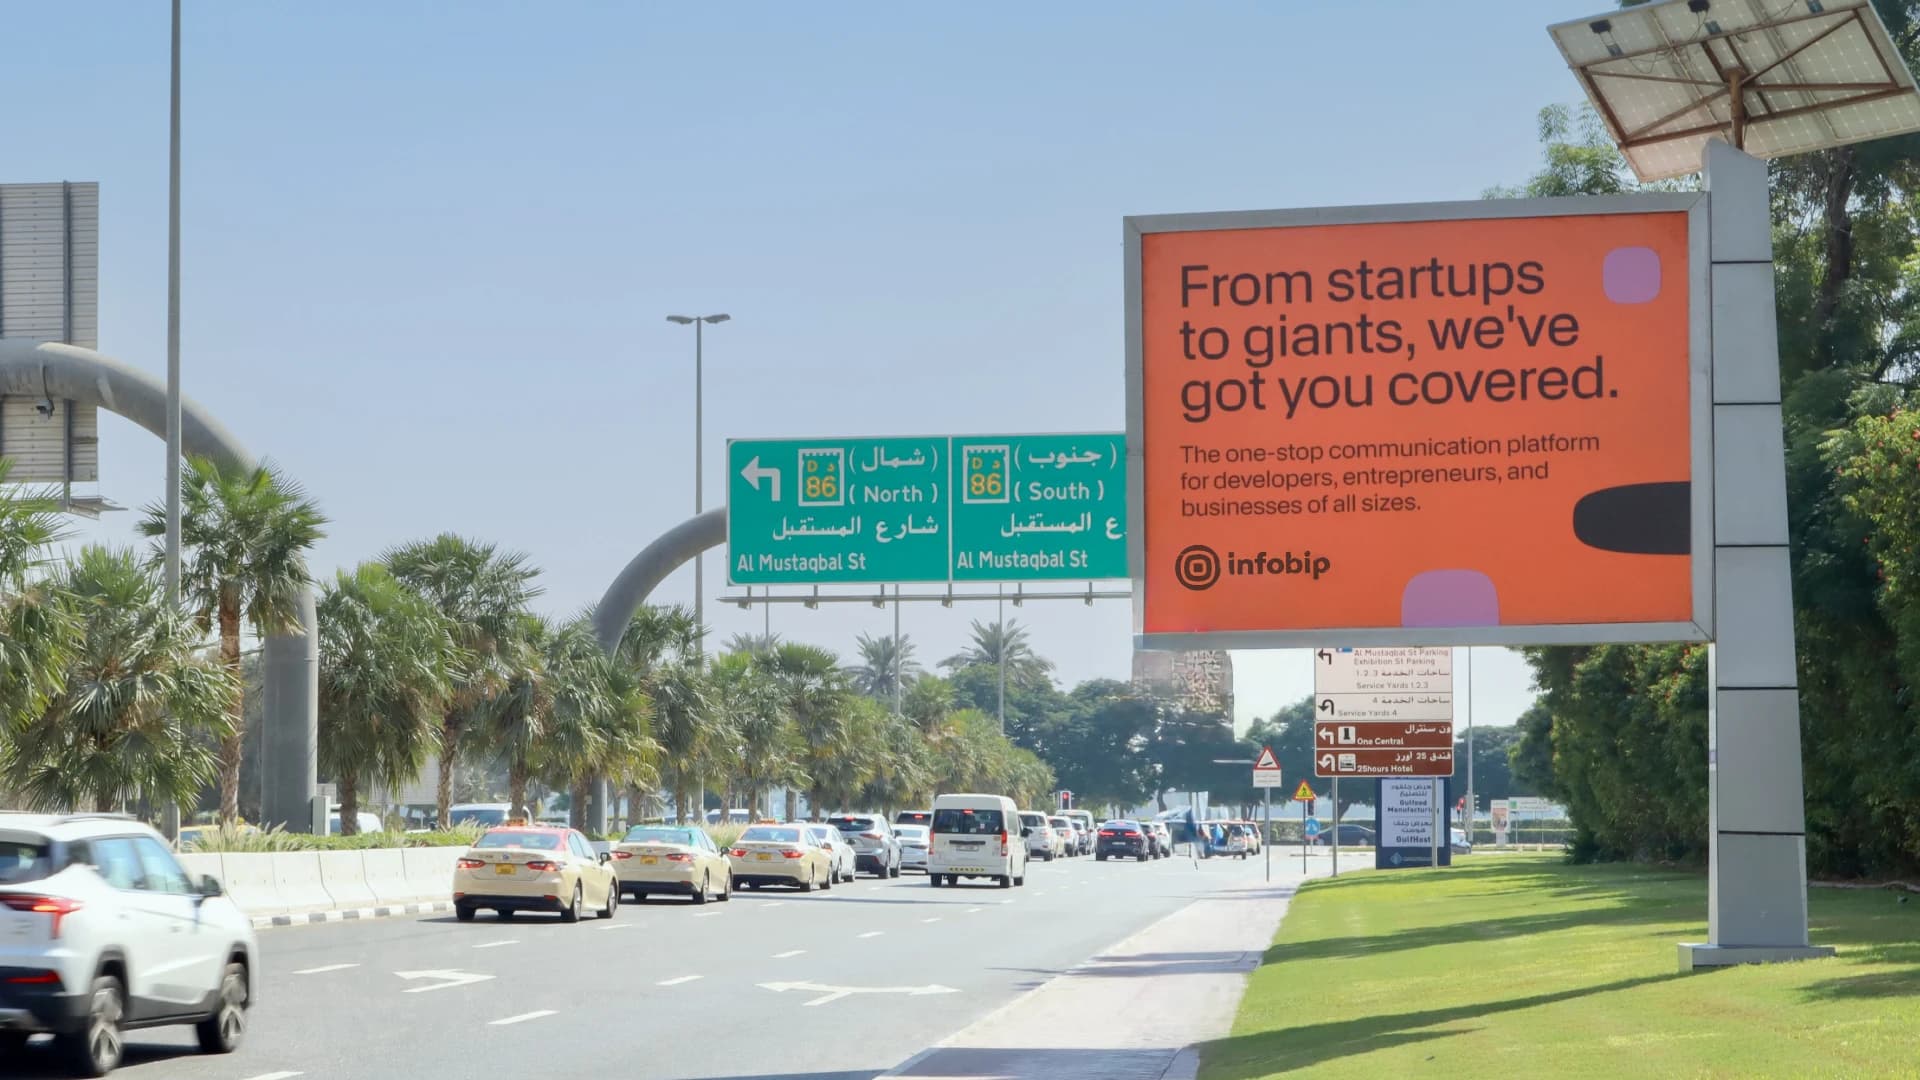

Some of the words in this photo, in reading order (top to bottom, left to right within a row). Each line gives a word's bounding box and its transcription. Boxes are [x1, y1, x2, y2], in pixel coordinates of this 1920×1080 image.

[1182, 265, 1312, 307] From
[1328, 258, 1545, 305] startups
[1180, 320, 1229, 360] to
[1243, 314, 1414, 368] giants,
[1428, 305, 1580, 350] we've
[1181, 371, 1266, 422] got
[1279, 375, 1372, 419] you
[1388, 355, 1618, 405] covered.
[1180, 445, 1220, 464] The
[1226, 444, 1323, 463] one-stop
[1329, 437, 1501, 459] communication
[1508, 433, 1600, 457] platform
[807, 460, 818, 473] D
[972, 457, 983, 470] D
[1181, 472, 1209, 490] for
[1214, 471, 1338, 490] developers,
[1343, 468, 1501, 487] entrepreneurs,
[1508, 461, 1548, 480] and
[806, 475, 837, 498] 86
[970, 472, 1002, 496] 86
[1182, 498, 1302, 516] businesses
[1308, 495, 1328, 513] of
[1333, 494, 1356, 512] all
[1362, 494, 1420, 512] sizes.
[772, 515, 861, 541] المستقبل
[875, 514, 939, 543] شارع
[1000, 511, 1092, 538] المستقبل
[737, 554, 754, 572] Al
[759, 553, 843, 574] Mustaqbal
[848, 552, 866, 570] St
[957, 551, 974, 569] Al
[979, 550, 1065, 570] Mustaqbal
[1069, 549, 1088, 568] St
[1229, 551, 1330, 580] infobip
[1407, 658, 1435, 666] Parking
[1420, 648, 1449, 657] Parking
[1374, 737, 1404, 745] Central
